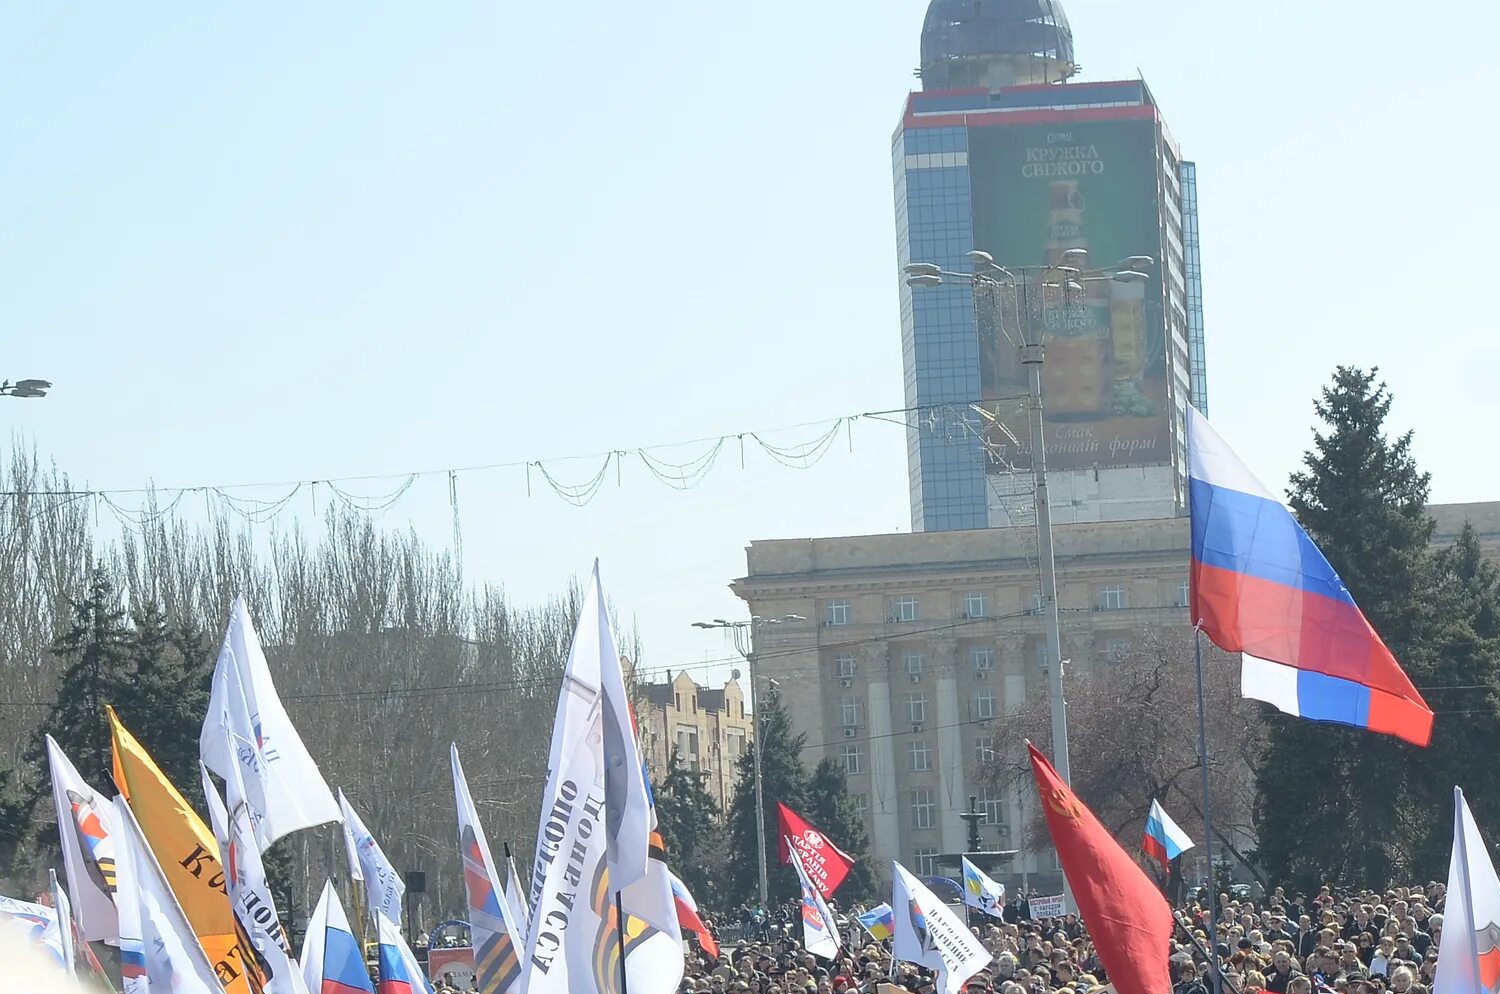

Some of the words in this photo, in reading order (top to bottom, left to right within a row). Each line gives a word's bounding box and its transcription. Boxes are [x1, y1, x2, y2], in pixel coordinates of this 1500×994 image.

[1025, 145, 1099, 161] КРУЖКА
[1022, 160, 1104, 177] СВІЖОГО
[1056, 424, 1094, 440] Смак
[1109, 434, 1157, 458] формі
